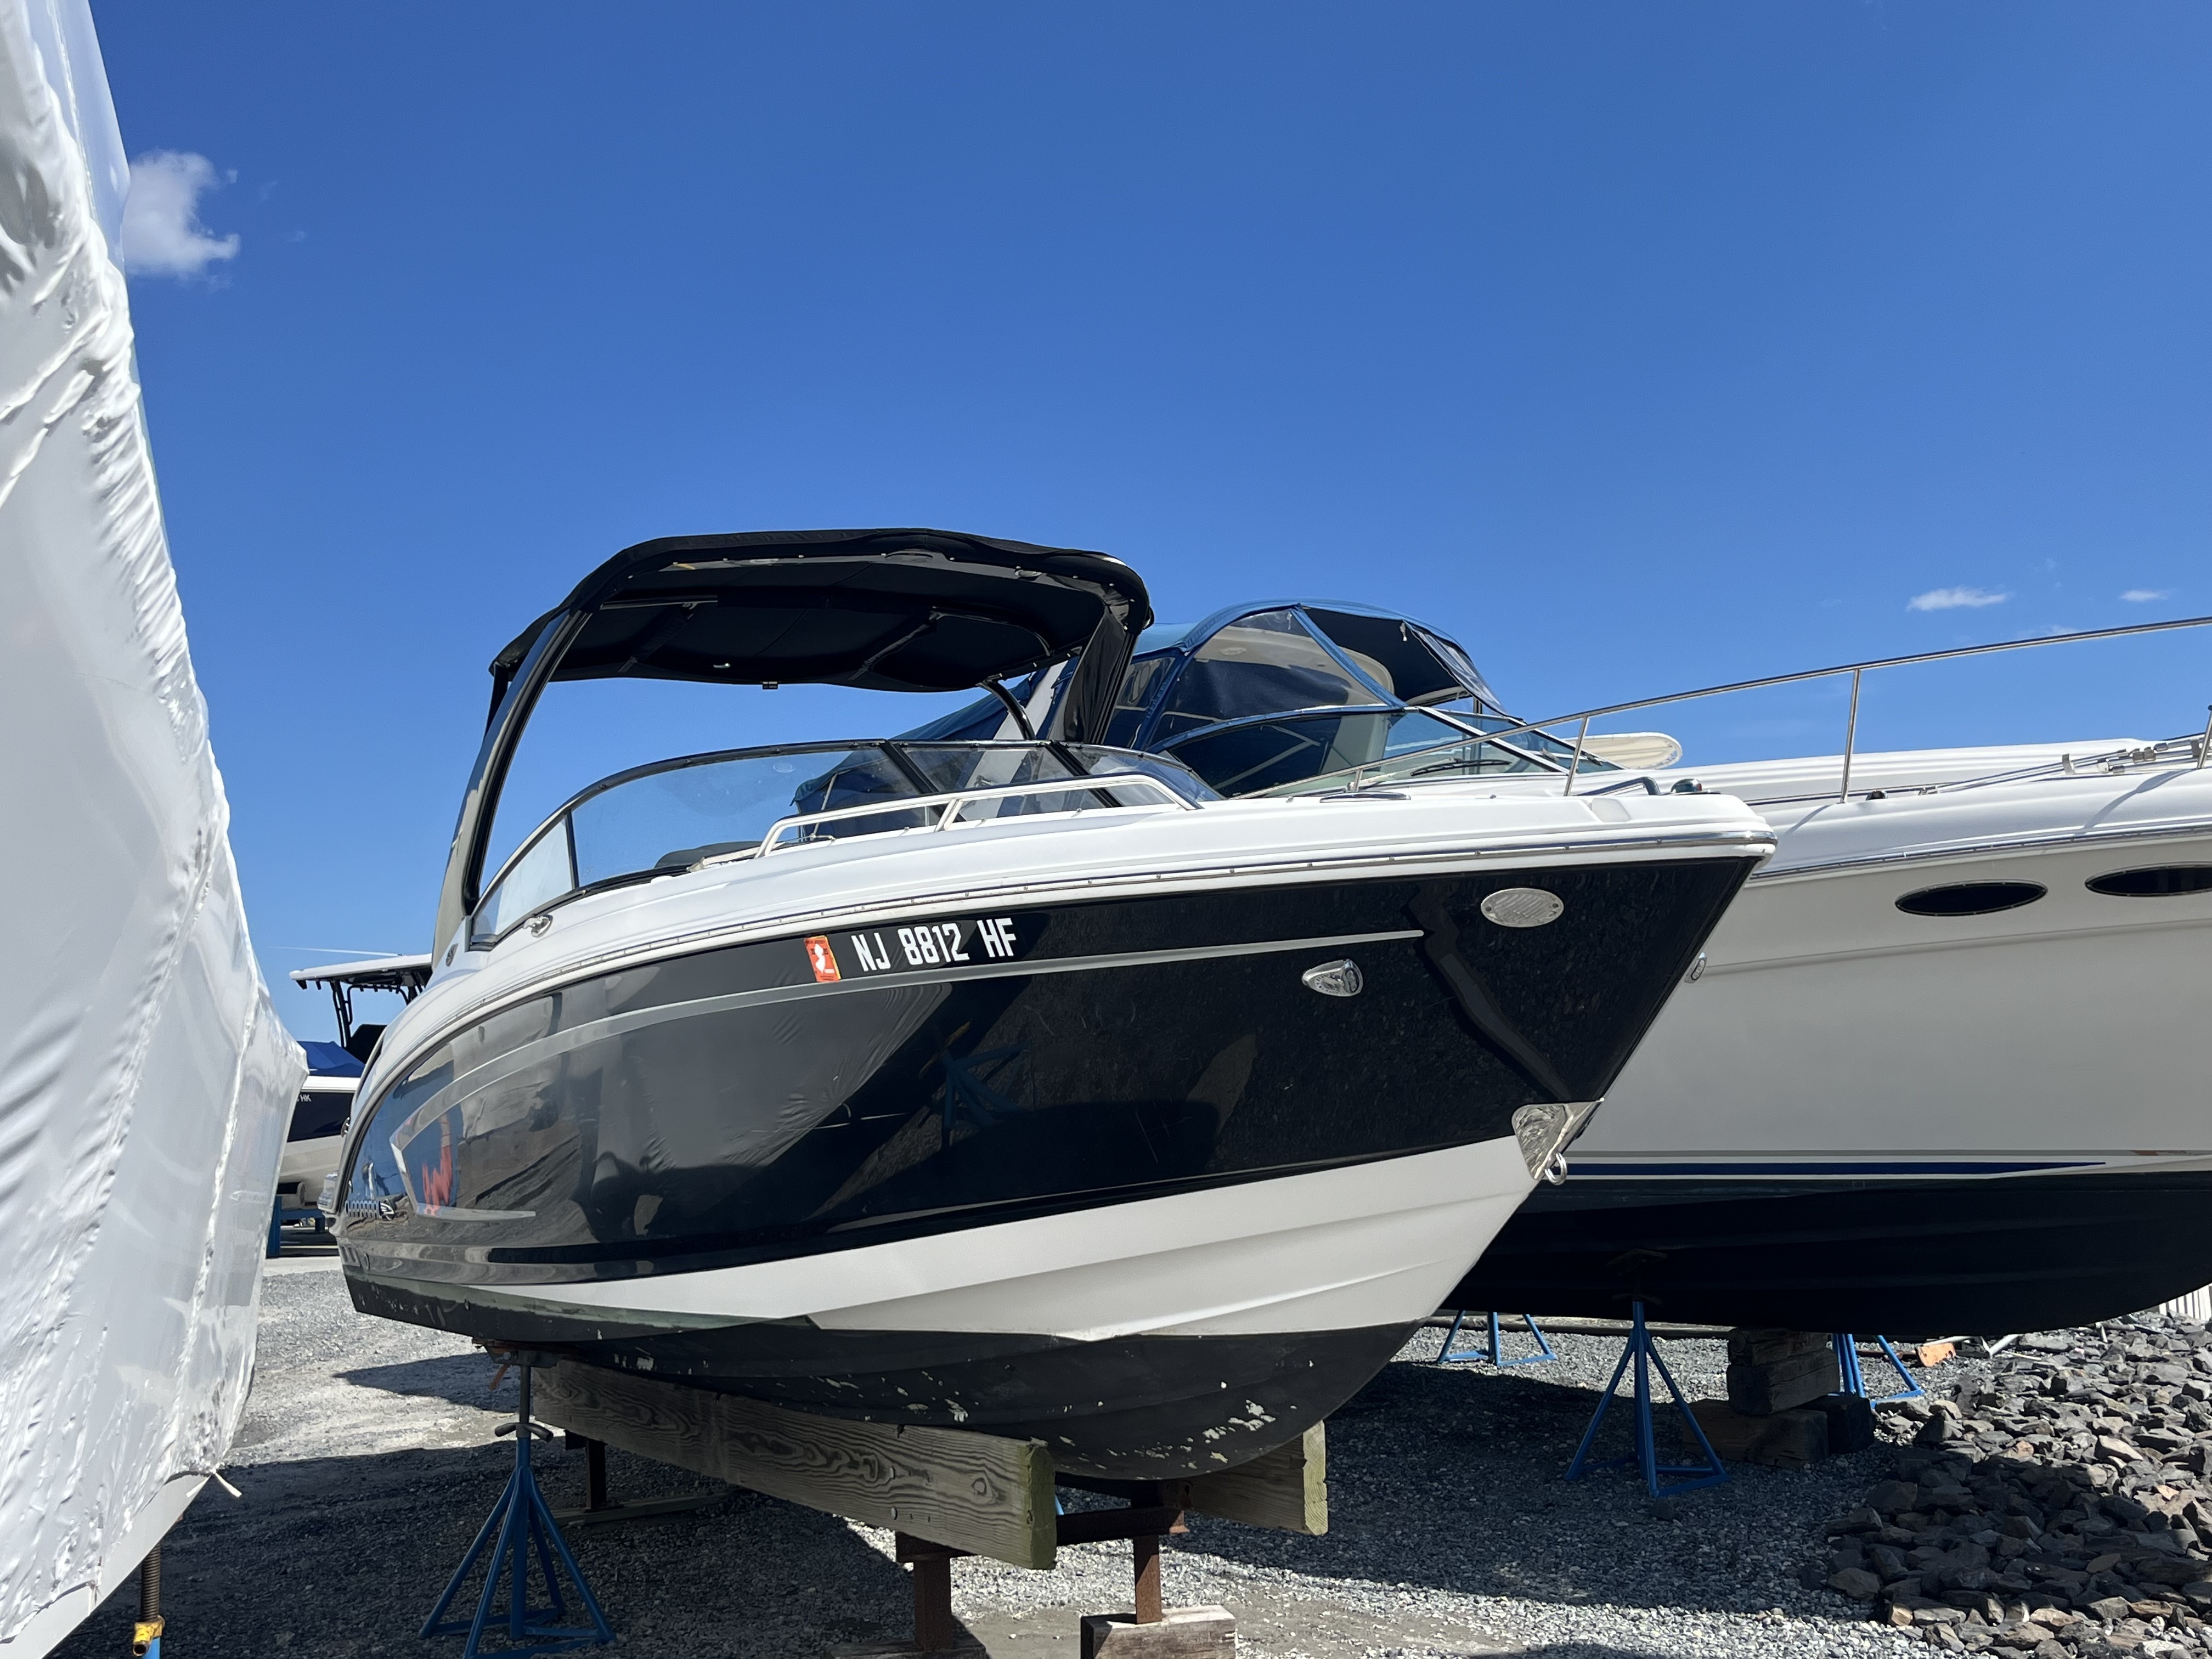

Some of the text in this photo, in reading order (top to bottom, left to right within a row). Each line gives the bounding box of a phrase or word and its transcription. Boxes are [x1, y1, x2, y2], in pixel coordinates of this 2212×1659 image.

[851, 917, 1017, 972] NJ 8812 HF
